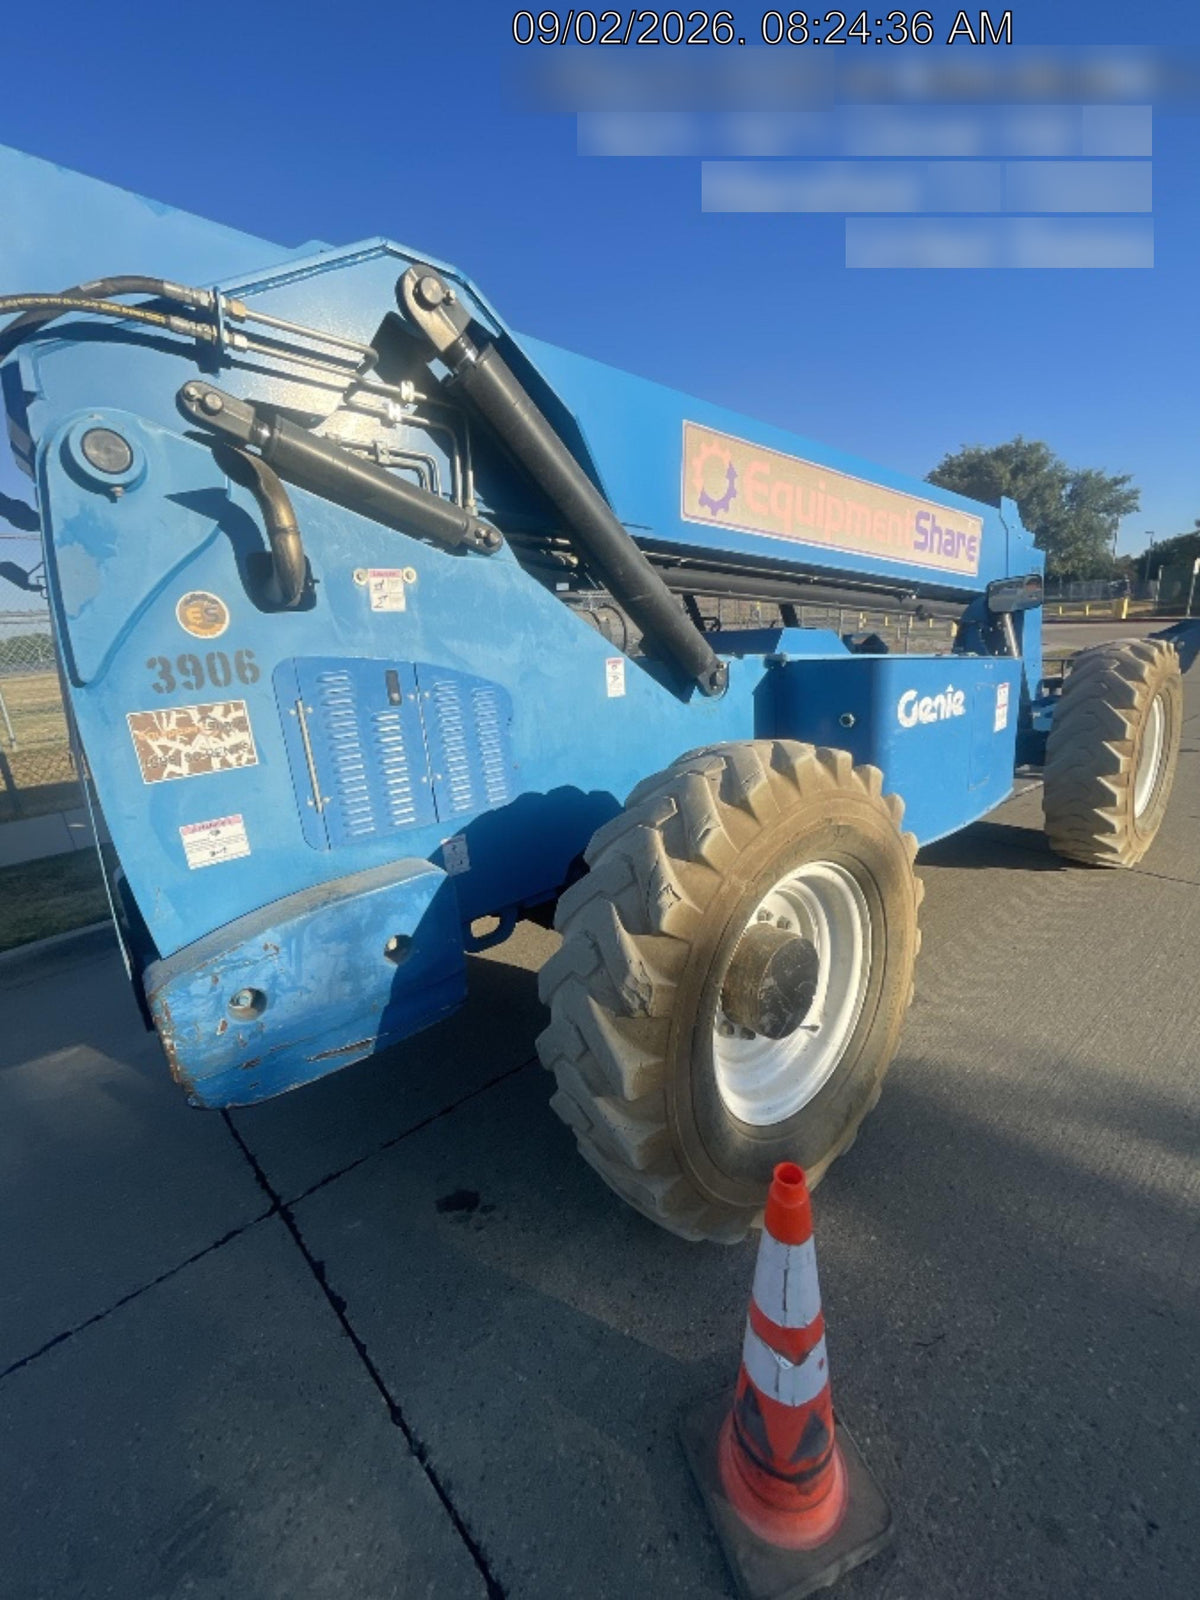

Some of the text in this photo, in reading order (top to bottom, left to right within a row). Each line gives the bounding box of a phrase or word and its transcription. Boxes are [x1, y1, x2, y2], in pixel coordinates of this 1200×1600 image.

[742, 461, 978, 562] EquipmentShare
[146, 649, 260, 694] 3906
[897, 684, 966, 728] Genie
